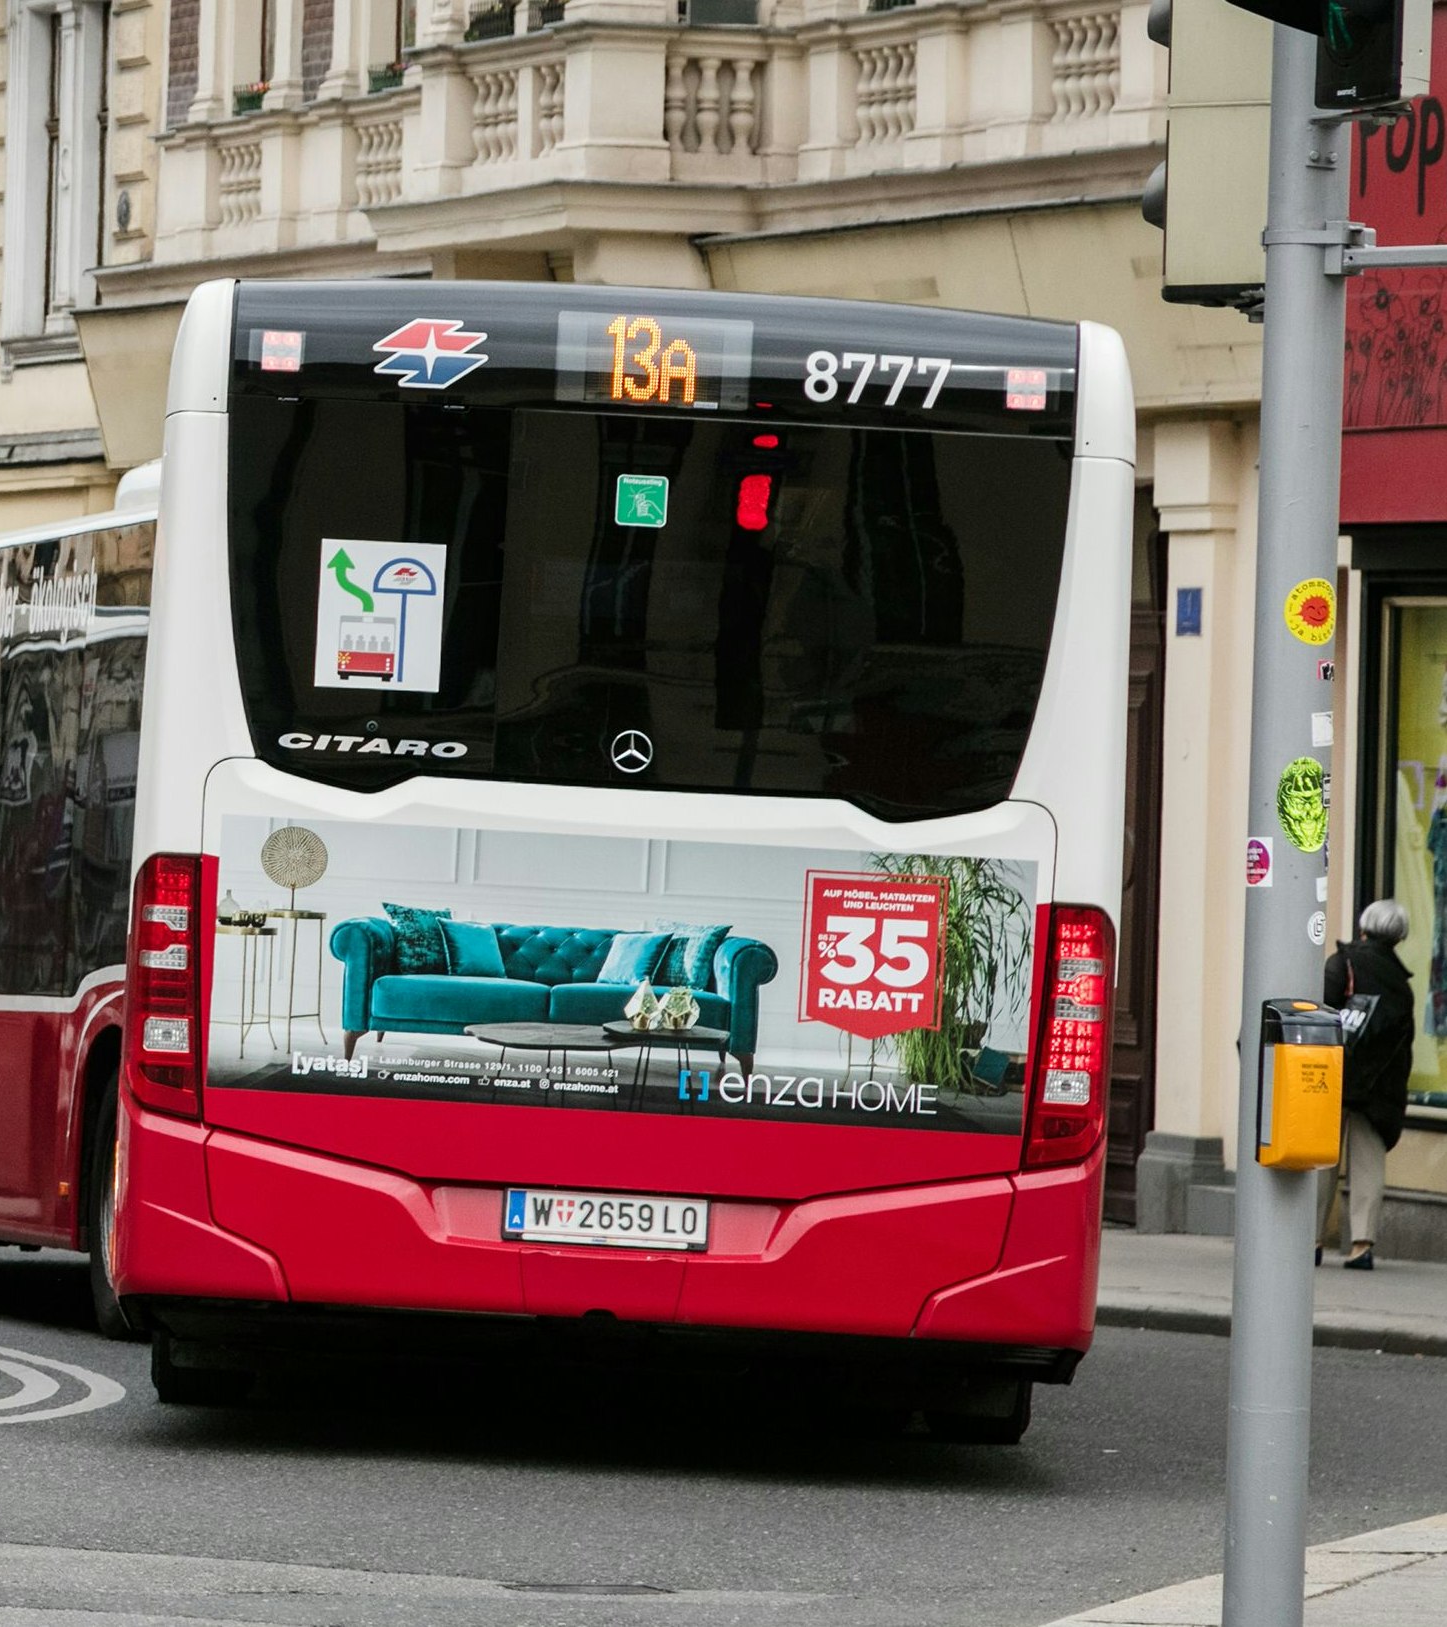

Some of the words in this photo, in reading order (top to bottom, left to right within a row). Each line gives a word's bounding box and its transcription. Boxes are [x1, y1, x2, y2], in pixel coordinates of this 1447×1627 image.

[607, 316, 697, 406] 13A
[805, 350, 952, 410] 8777
[29, 557, 98, 646] ökologisch
[278, 732, 468, 759] CITARO
[823, 889, 843, 898] AUF
[879, 892, 936, 904] MATRATZEN
[843, 901, 864, 909] UND
[865, 902, 915, 912] LEUCHTEN
[820, 915, 930, 988] 35
[818, 988, 925, 1013] RABATT
[379, 1055, 441, 1069] Laxenburger
[443, 1059, 481, 1070] Strasse
[485, 1062, 515, 1072] 129/1,
[519, 1063, 543, 1073] 1100
[545, 1066, 564, 1075] +43
[575, 1067, 599, 1077] 6005
[602, 1069, 619, 1078] 421
[393, 1072, 470, 1085] enzahome.com
[494, 1078, 531, 1089] enza.at
[554, 1081, 619, 1094] enzahome.at
[719, 1072, 824, 1108] enza
[832, 1079, 939, 1115] HOME
[533, 1196, 554, 1227] W
[578, 1200, 654, 1232] 2659
